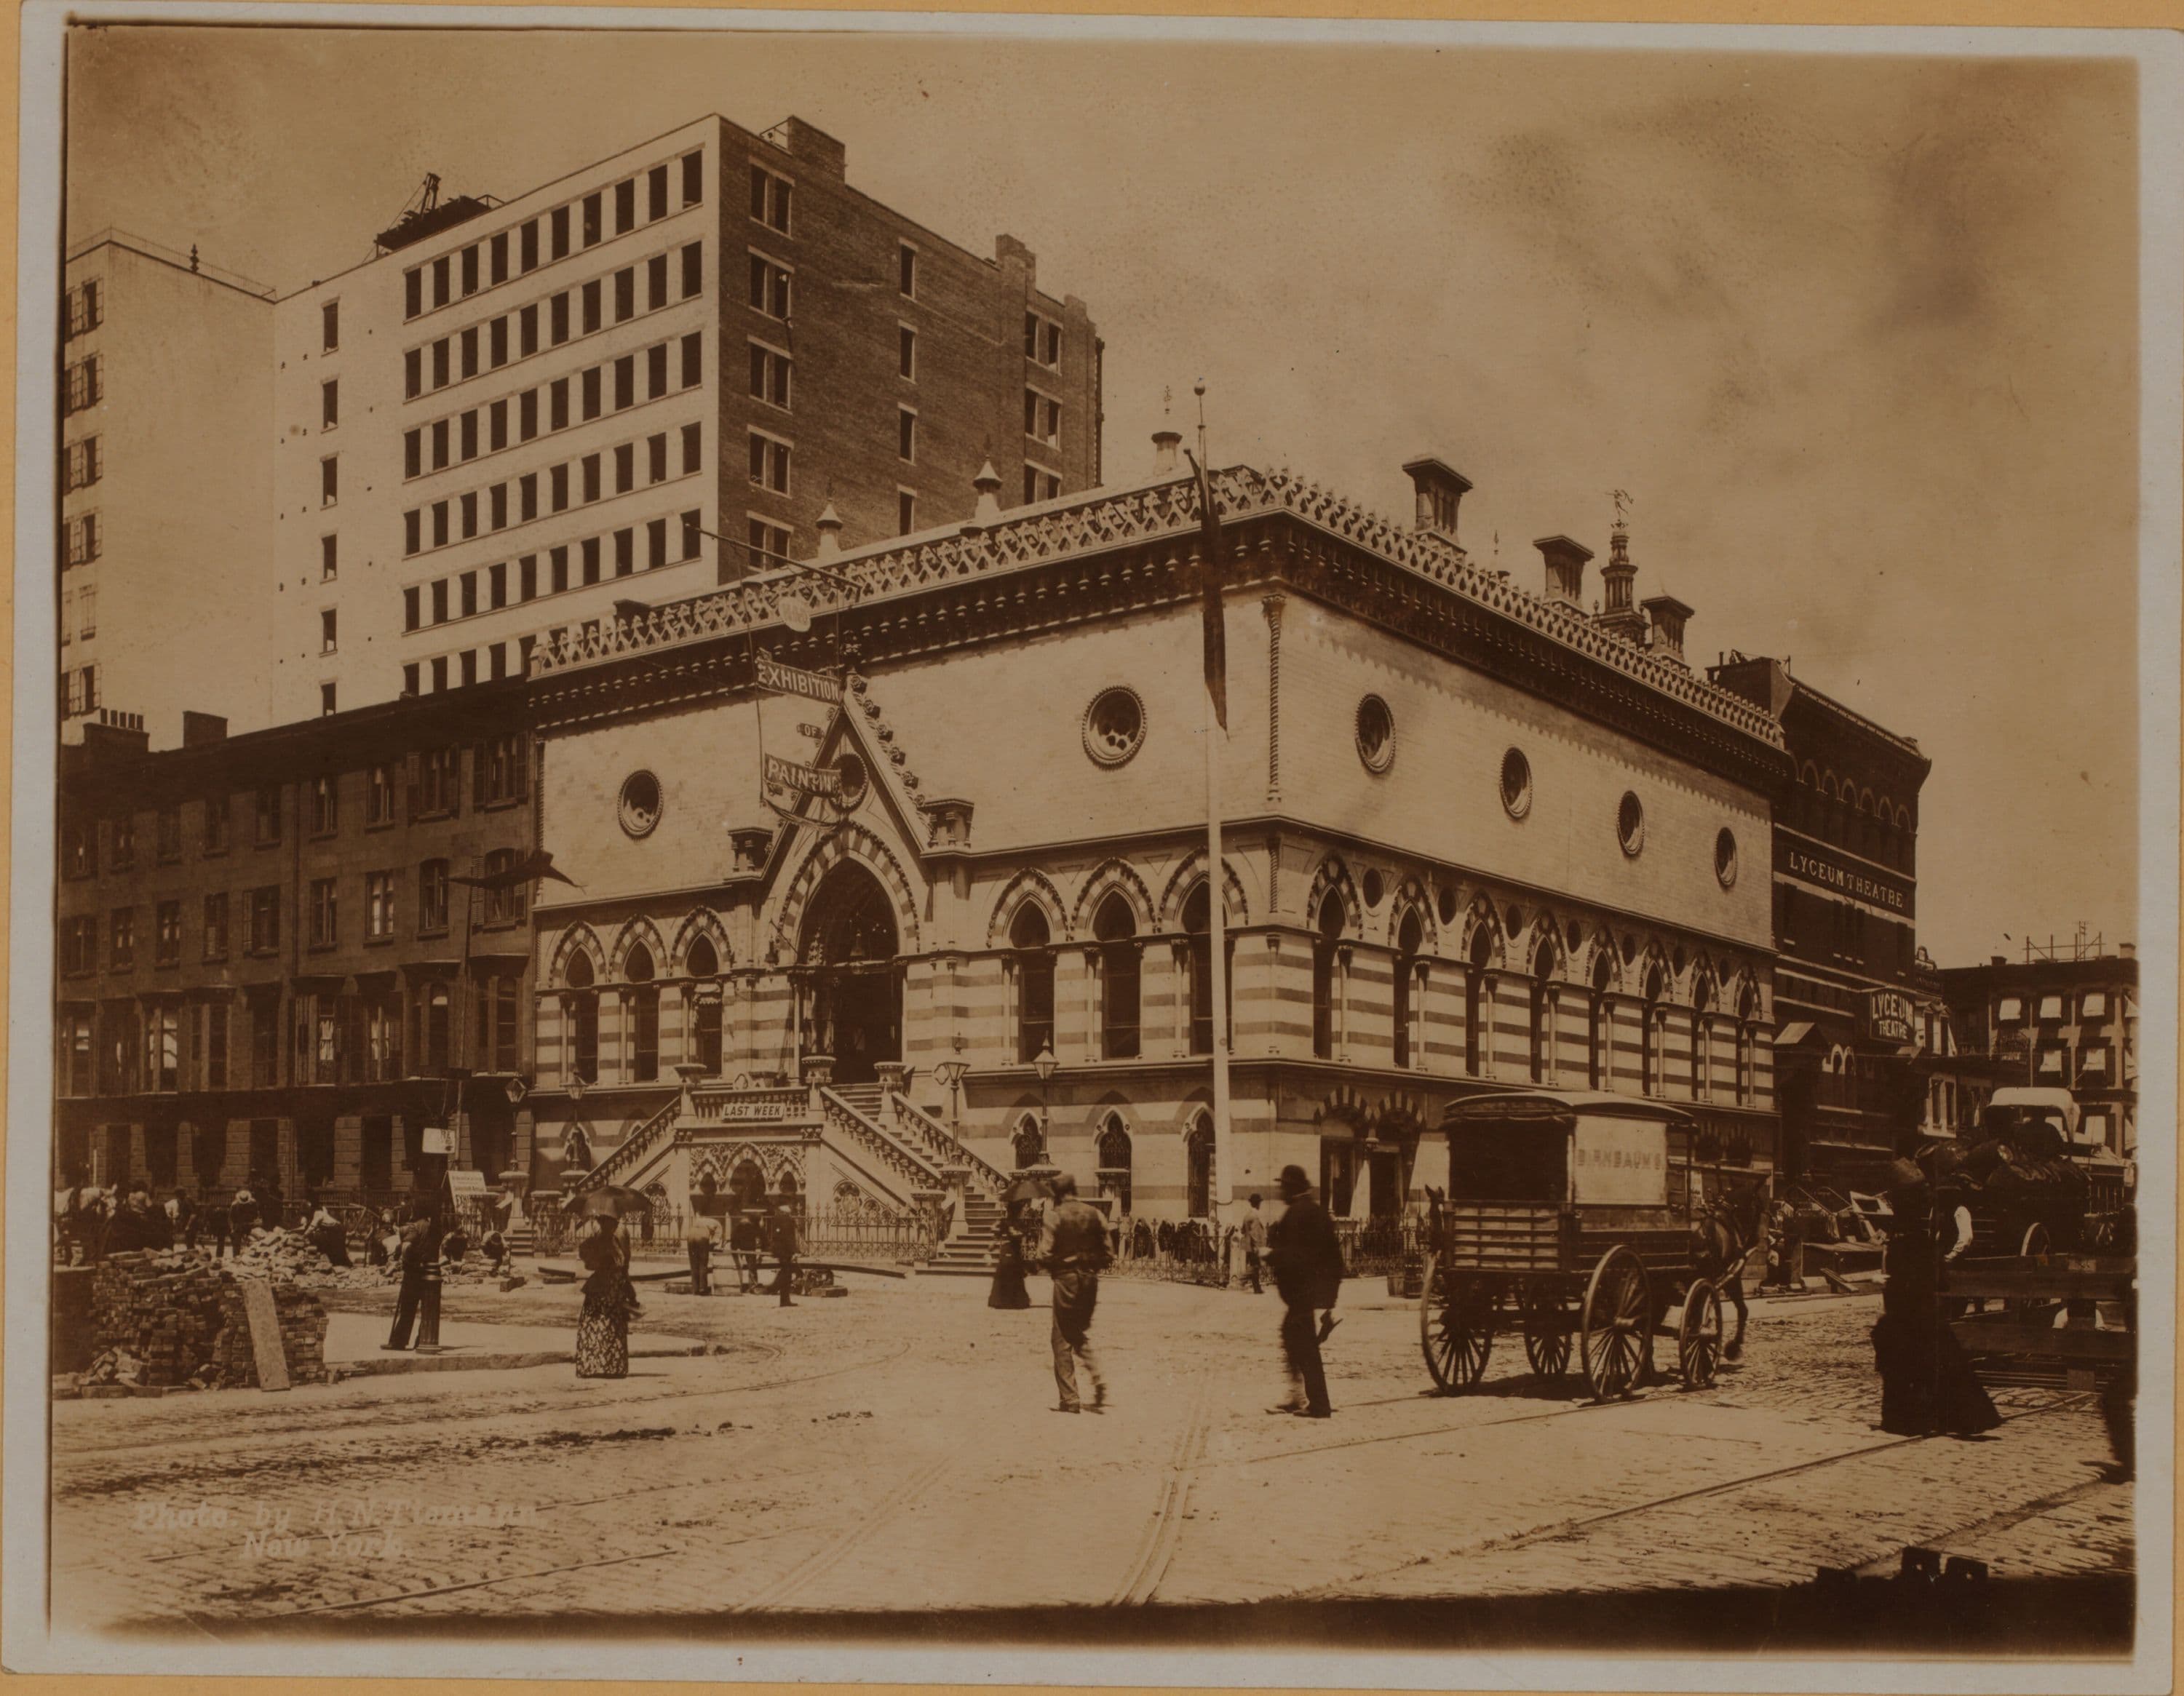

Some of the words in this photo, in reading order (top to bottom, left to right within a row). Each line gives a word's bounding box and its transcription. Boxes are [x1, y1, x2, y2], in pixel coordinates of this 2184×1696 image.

[758, 661, 838, 701] EXHIBITION
[804, 725, 817, 736] OF
[1790, 852, 1845, 887] LYCEUM
[1847, 874, 1903, 908] THEATRE
[1872, 992, 1913, 1026] LYCEUM
[1879, 1019, 1908, 1040] THEATRE
[724, 1105, 749, 1116] LAST
[754, 1105, 781, 1115] WEEK
